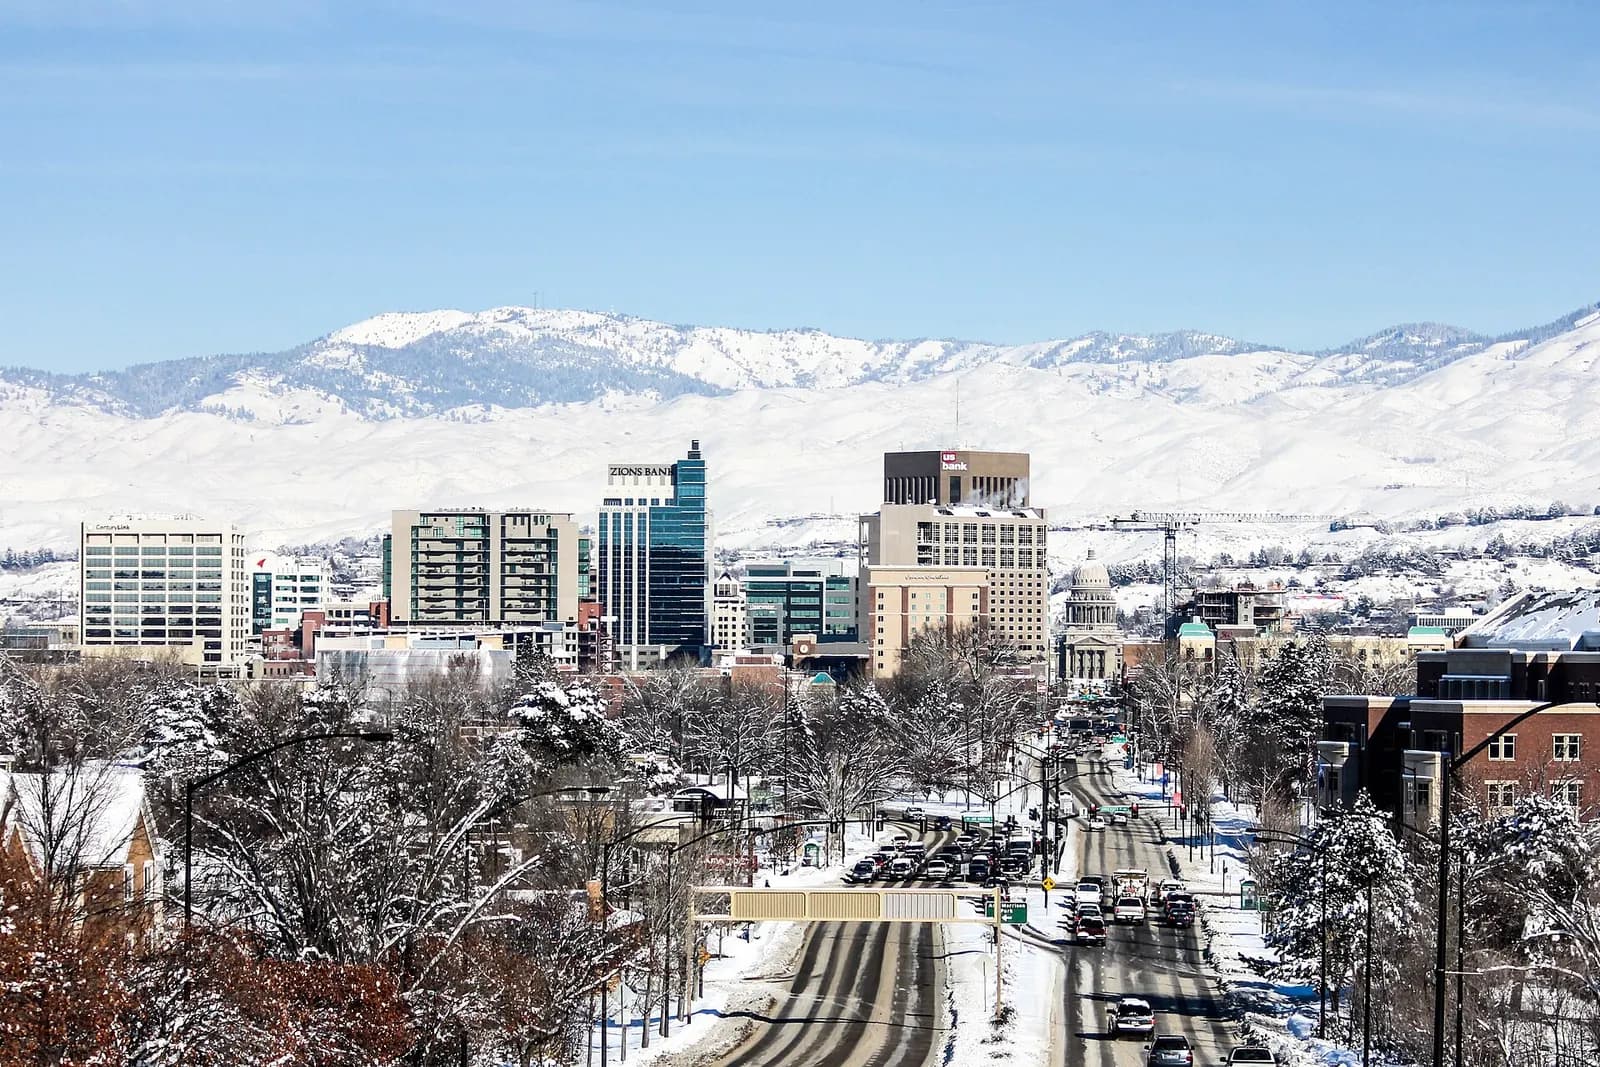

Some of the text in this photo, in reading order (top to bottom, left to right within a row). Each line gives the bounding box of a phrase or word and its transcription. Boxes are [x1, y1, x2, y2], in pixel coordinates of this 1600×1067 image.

[942, 453, 956, 461] us
[942, 461, 968, 471] bank
[610, 467, 643, 476] ZIONS
